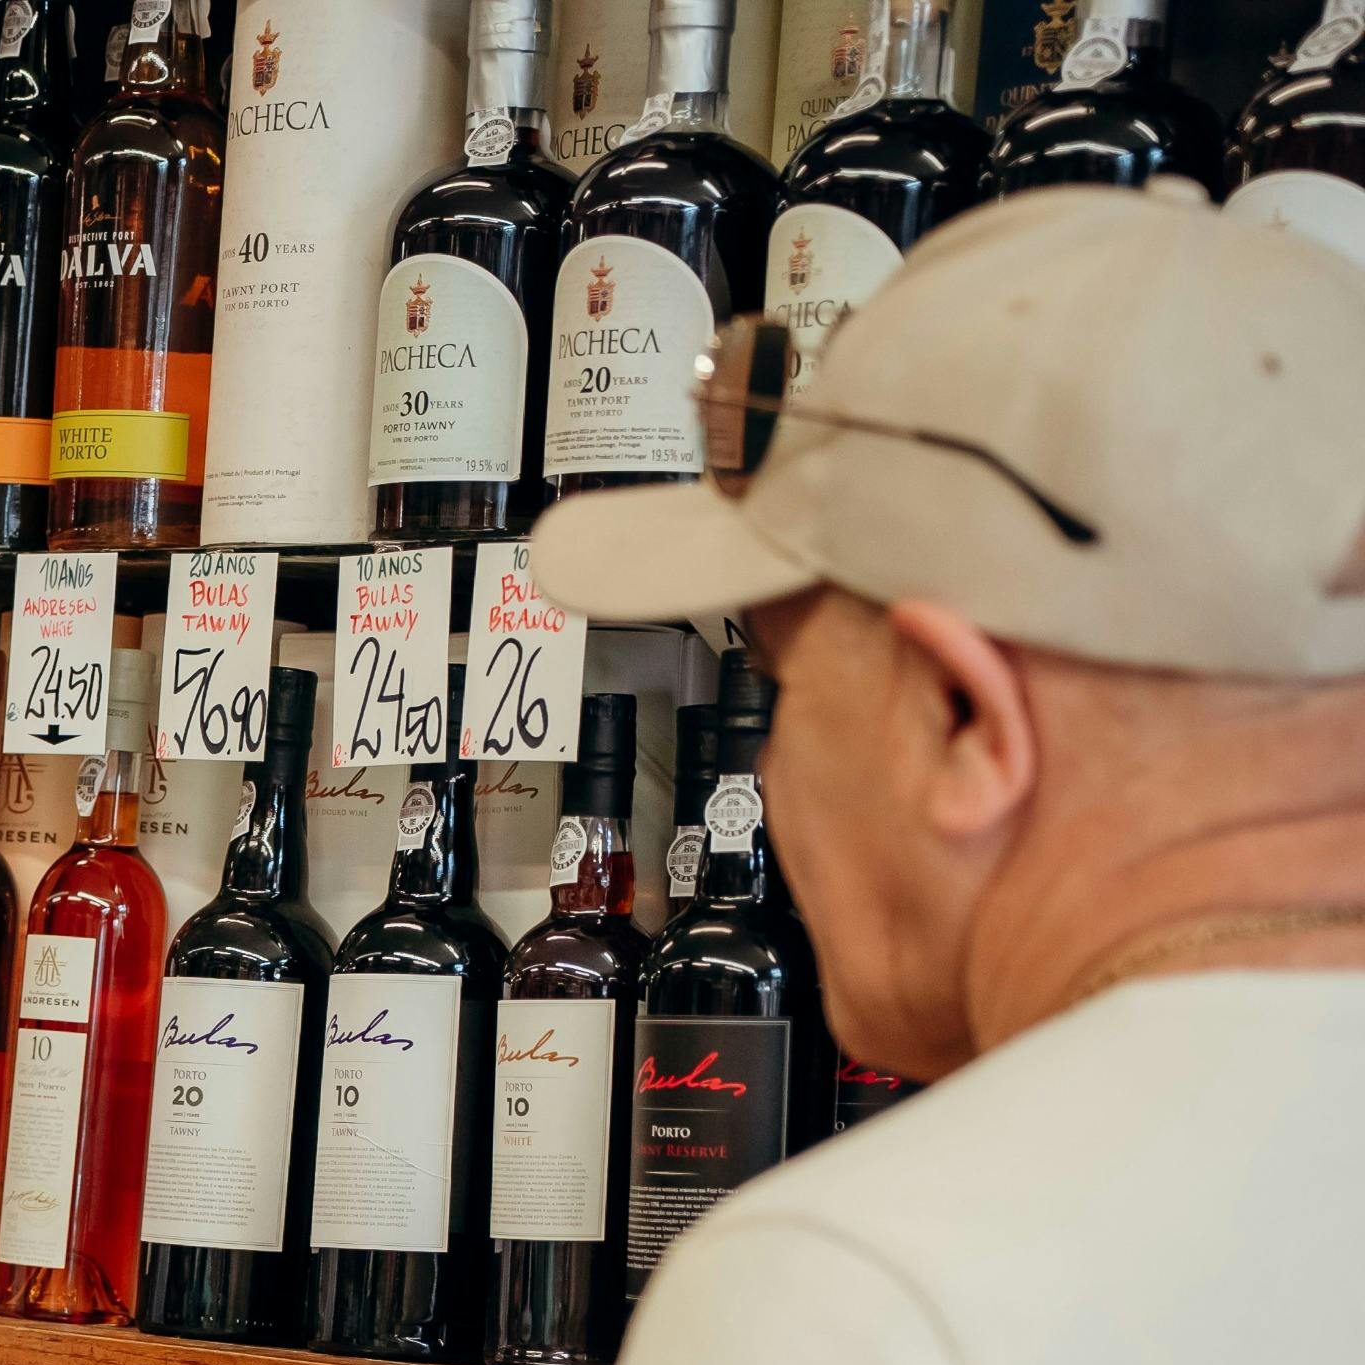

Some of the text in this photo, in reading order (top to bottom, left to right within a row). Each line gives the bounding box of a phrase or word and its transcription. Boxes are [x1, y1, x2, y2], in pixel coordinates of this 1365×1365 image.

[228, 100, 331, 141] PACHECA
[112, 231, 136, 242] PORT
[238, 232, 316, 264] 40 YEARS
[60, 243, 157, 282] DALVA
[93, 280, 115, 289] 1862
[222, 282, 300, 299] TAWNY PORT
[238, 301, 250, 310] DE
[252, 299, 289, 309] PORTO
[558, 328, 662, 360] PACHECA
[380, 343, 477, 375] PACHECA
[580, 366, 611, 393] 20
[613, 377, 649, 385] YEARS
[400, 390, 429, 417] 30
[430, 400, 464, 409] YEARS
[567, 396, 630, 407] TAWNY PORT
[595, 409, 623, 417] PORTO
[59, 427, 113, 445] WHITE
[384, 421, 456, 433] PORTO TAWNY
[59, 444, 108, 461] PORTO
[652, 448, 694, 462] 19.5% vol
[466, 460, 509, 472] 19.5% vol
[213, 555, 257, 576] ANOS
[356, 552, 423, 582] 10 ANOS
[513, 544, 530, 571] 10
[188, 579, 250, 608] BULAS
[355, 583, 414, 611] BULAS
[22, 597, 97, 617] ANDRESEN
[350, 608, 419, 642] TAWNY
[489, 605, 566, 633] BRANCO
[24, 645, 103, 721] 24.50
[173, 647, 268, 756] 56.90
[349, 636, 443, 761] 24.50
[348, 808, 368, 817] WINE
[503, 805, 523, 814] WINE
[24, 997, 80, 1008] ANDRESEN
[158, 1013, 259, 1055] Bulas
[327, 1009, 414, 1051] Bulas
[31, 1035, 52, 1062] 10
[497, 1029, 579, 1067] Bulas
[172, 1085, 204, 1107] 20
[336, 1085, 360, 1108] 10
[506, 1097, 530, 1117] 10
[170, 1127, 201, 1137] TAWNY
[331, 1127, 358, 1138] TAWNY
